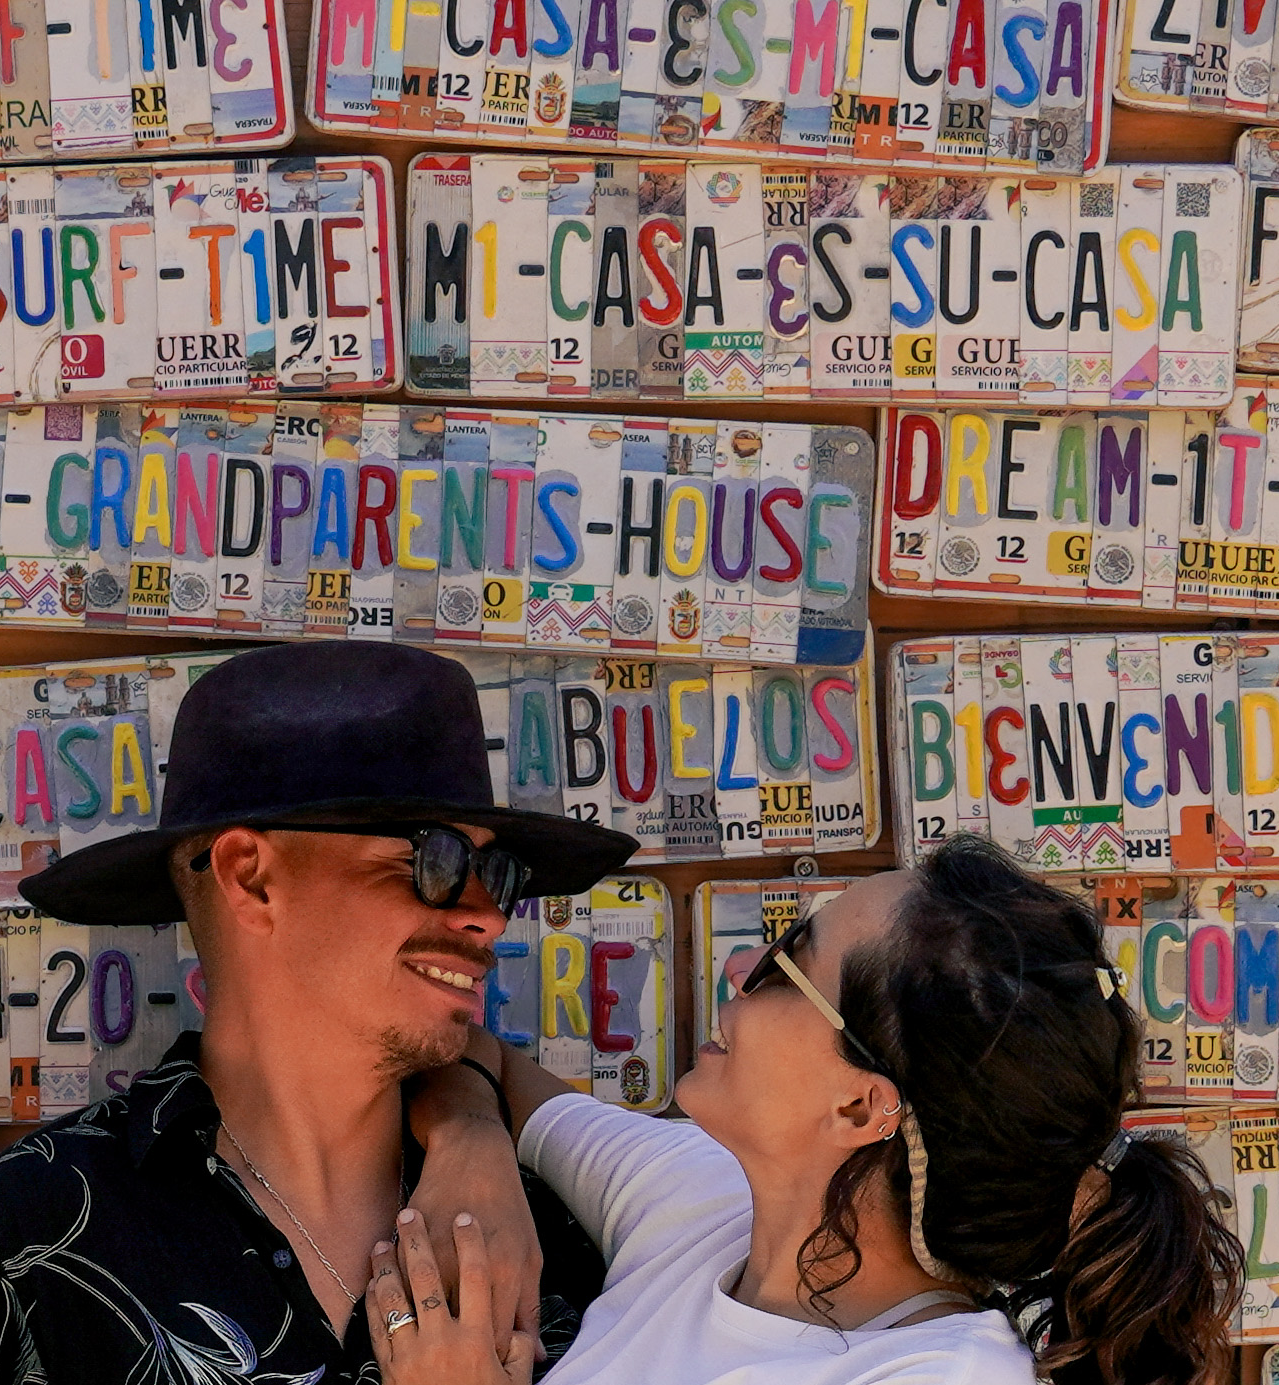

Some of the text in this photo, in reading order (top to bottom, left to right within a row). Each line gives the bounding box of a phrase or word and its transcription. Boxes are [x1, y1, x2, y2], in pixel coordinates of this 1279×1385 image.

[441, 73, 470, 97] 12
[898, 102, 929, 126] 12
[329, 333, 359, 357] 12
[550, 337, 580, 360] 12
[996, 535, 1025, 559] 12
[220, 572, 250, 596] 12
[1247, 808, 1277, 831] 12
[474, 933, 635, 1053] ERE
